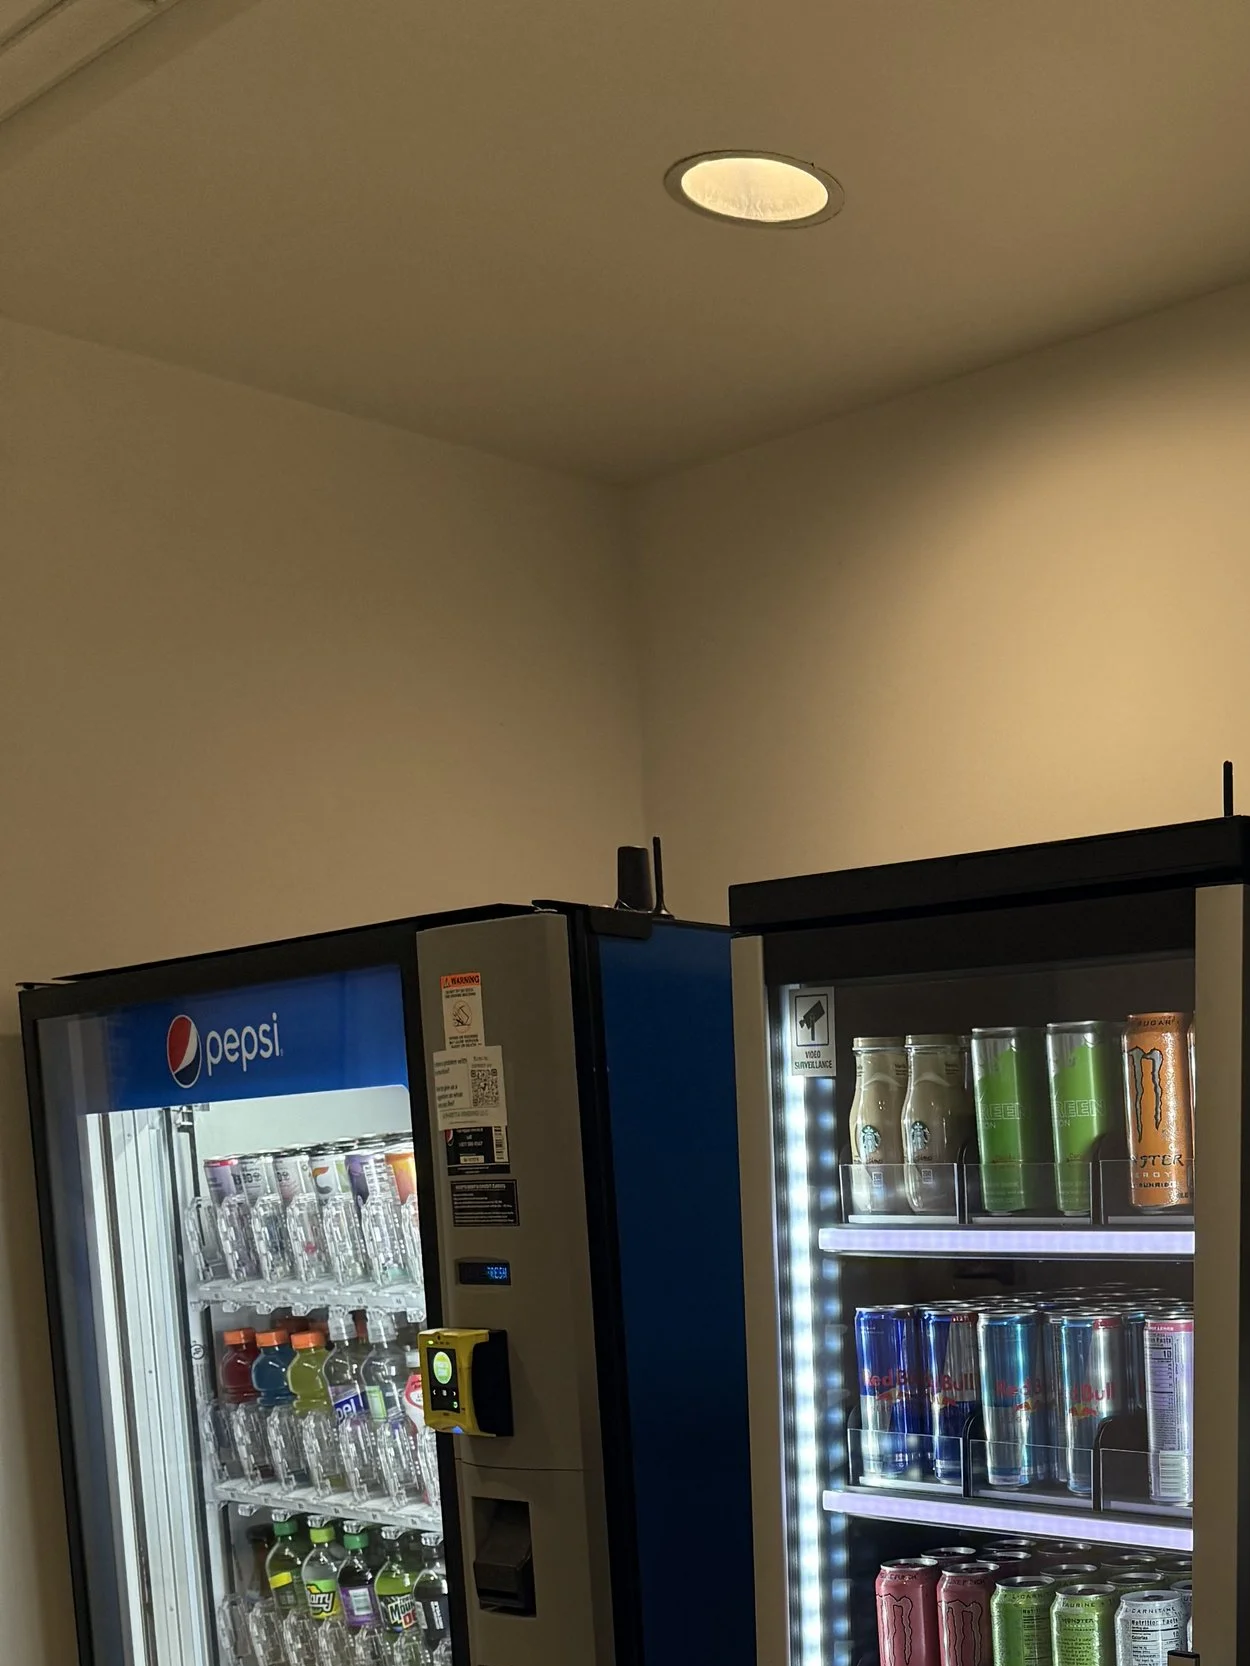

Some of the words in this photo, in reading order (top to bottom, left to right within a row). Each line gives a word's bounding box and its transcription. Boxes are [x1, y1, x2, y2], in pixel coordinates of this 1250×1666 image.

[451, 975, 480, 985] WARNING
[206, 1011, 280, 1077] pepsi
[804, 1050, 822, 1059] VIDEO
[794, 1059, 833, 1070] SURVEILLANCE
